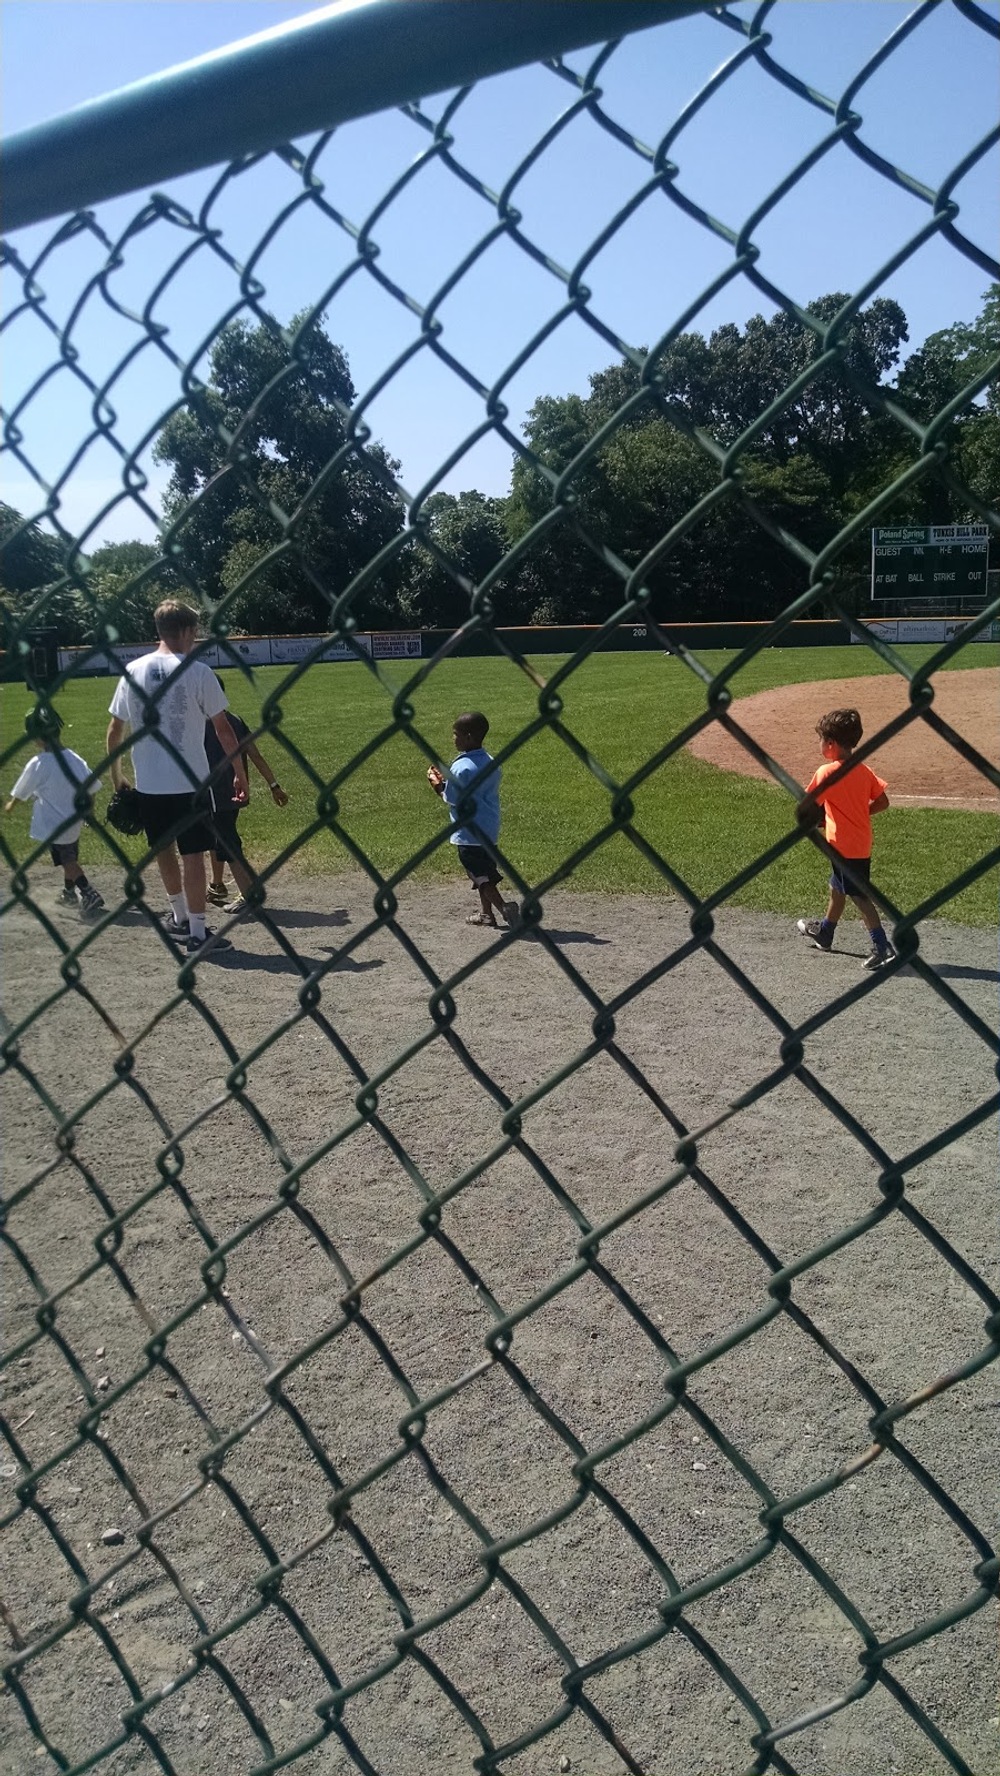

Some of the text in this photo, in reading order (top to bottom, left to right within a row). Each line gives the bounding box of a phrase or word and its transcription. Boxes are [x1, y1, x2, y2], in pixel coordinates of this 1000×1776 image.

[879, 528, 925, 540] Poland Spring
[971, 527, 987, 536] PARK
[875, 547, 902, 556] GUEST
[961, 545, 987, 553] HOME
[875, 574, 898, 583] AT BAT
[908, 573, 924, 582] BALL
[933, 572, 956, 581] STRIKE
[967, 571, 982, 580] OUT
[633, 628, 647, 637] 200
